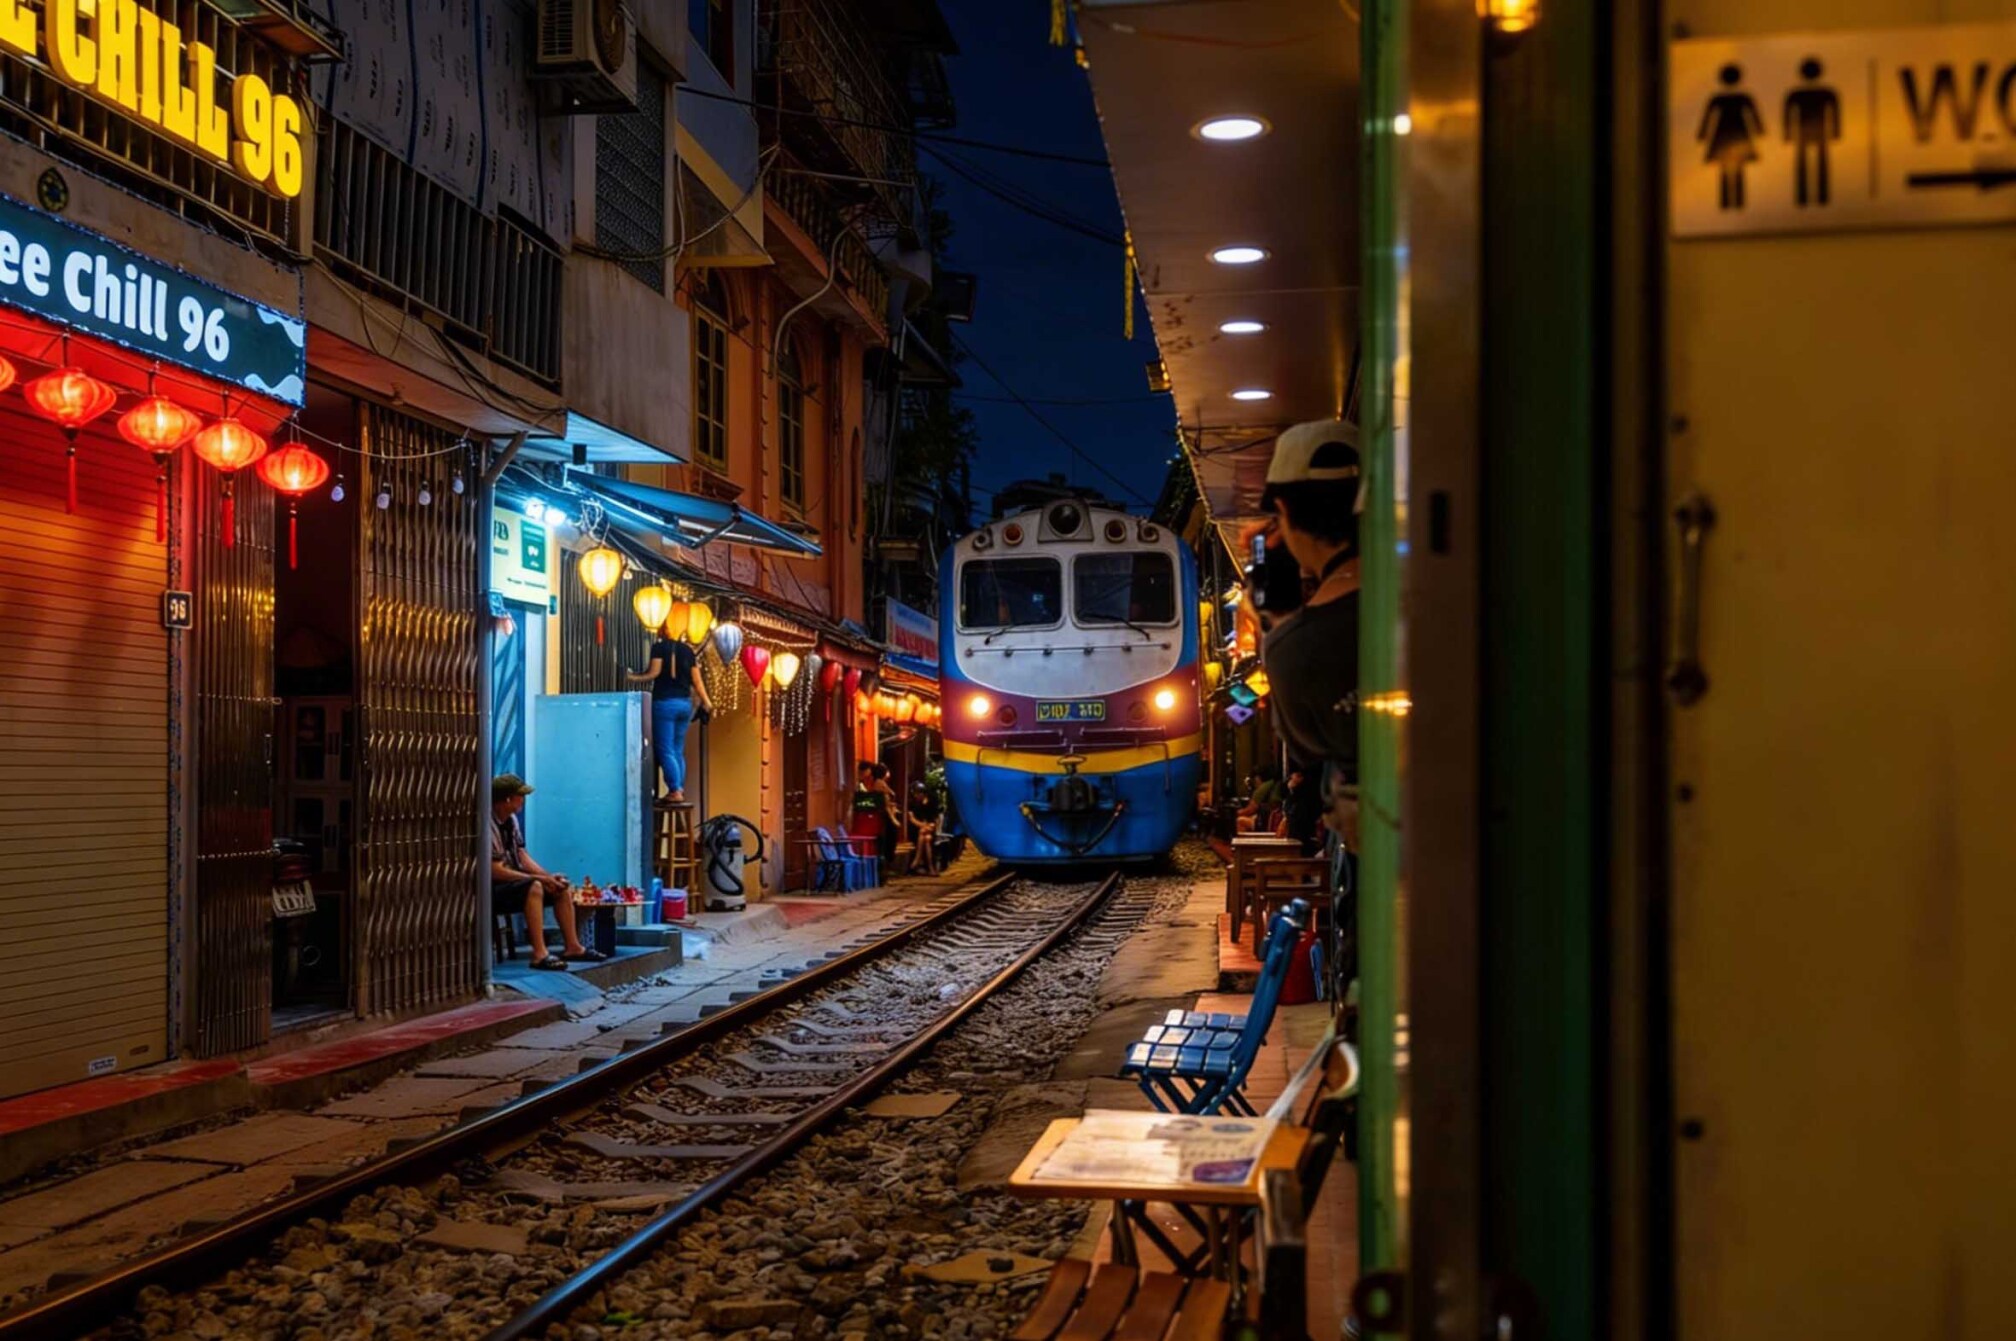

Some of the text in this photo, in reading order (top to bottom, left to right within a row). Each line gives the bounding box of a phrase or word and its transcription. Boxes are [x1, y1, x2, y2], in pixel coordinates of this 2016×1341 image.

[47, 0, 302, 197] CHILL 96
[63, 251, 168, 342] Chill
[178, 296, 230, 362] 96
